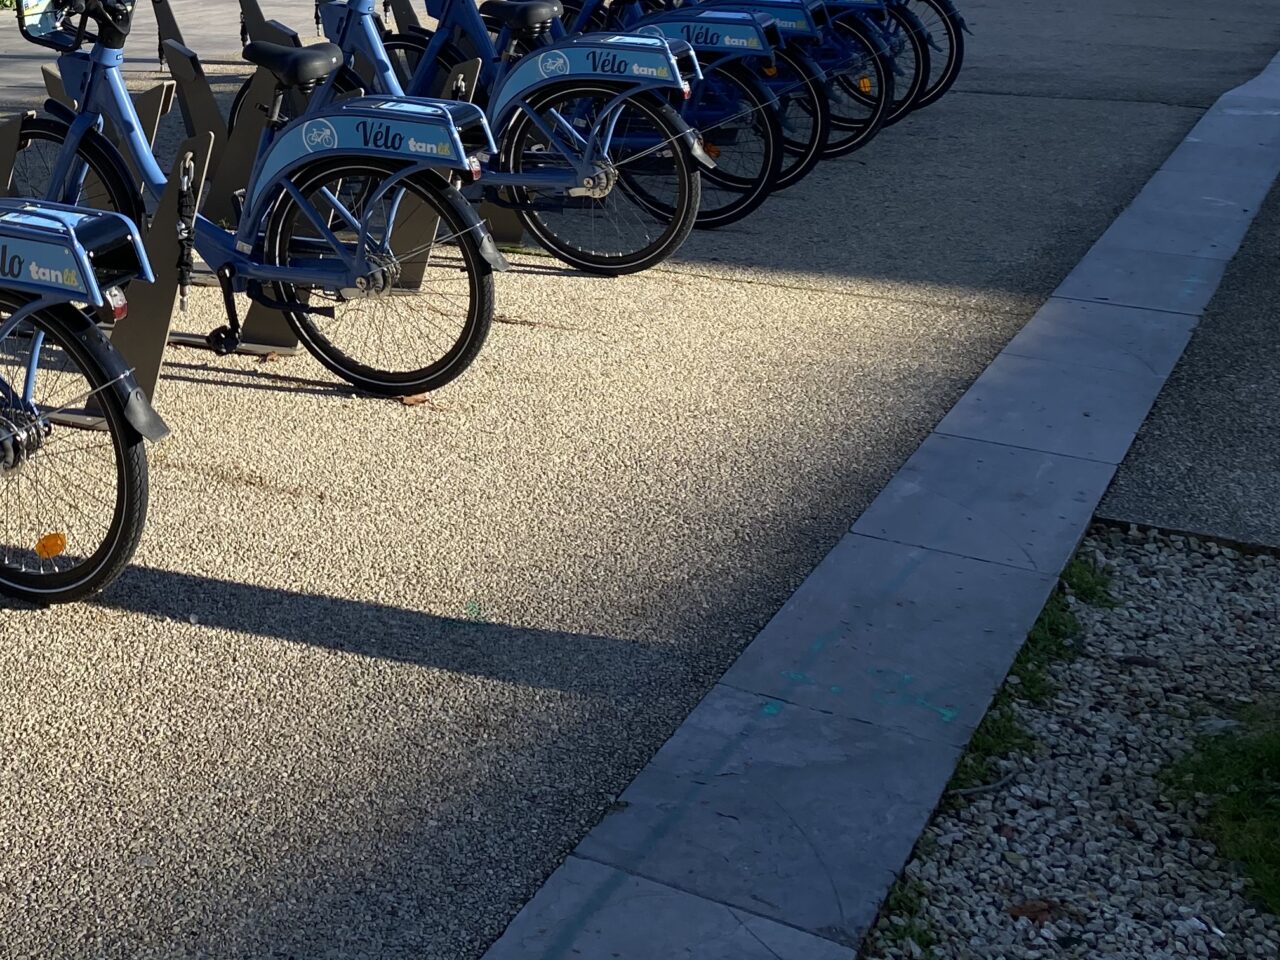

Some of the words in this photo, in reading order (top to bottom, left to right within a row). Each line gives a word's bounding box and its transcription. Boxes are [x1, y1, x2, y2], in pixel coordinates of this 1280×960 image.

[680, 24, 722, 46] Vélo
[586, 51, 629, 75] Vélo
[355, 120, 404, 151] Vélo
[28, 260, 79, 287] tanlib
